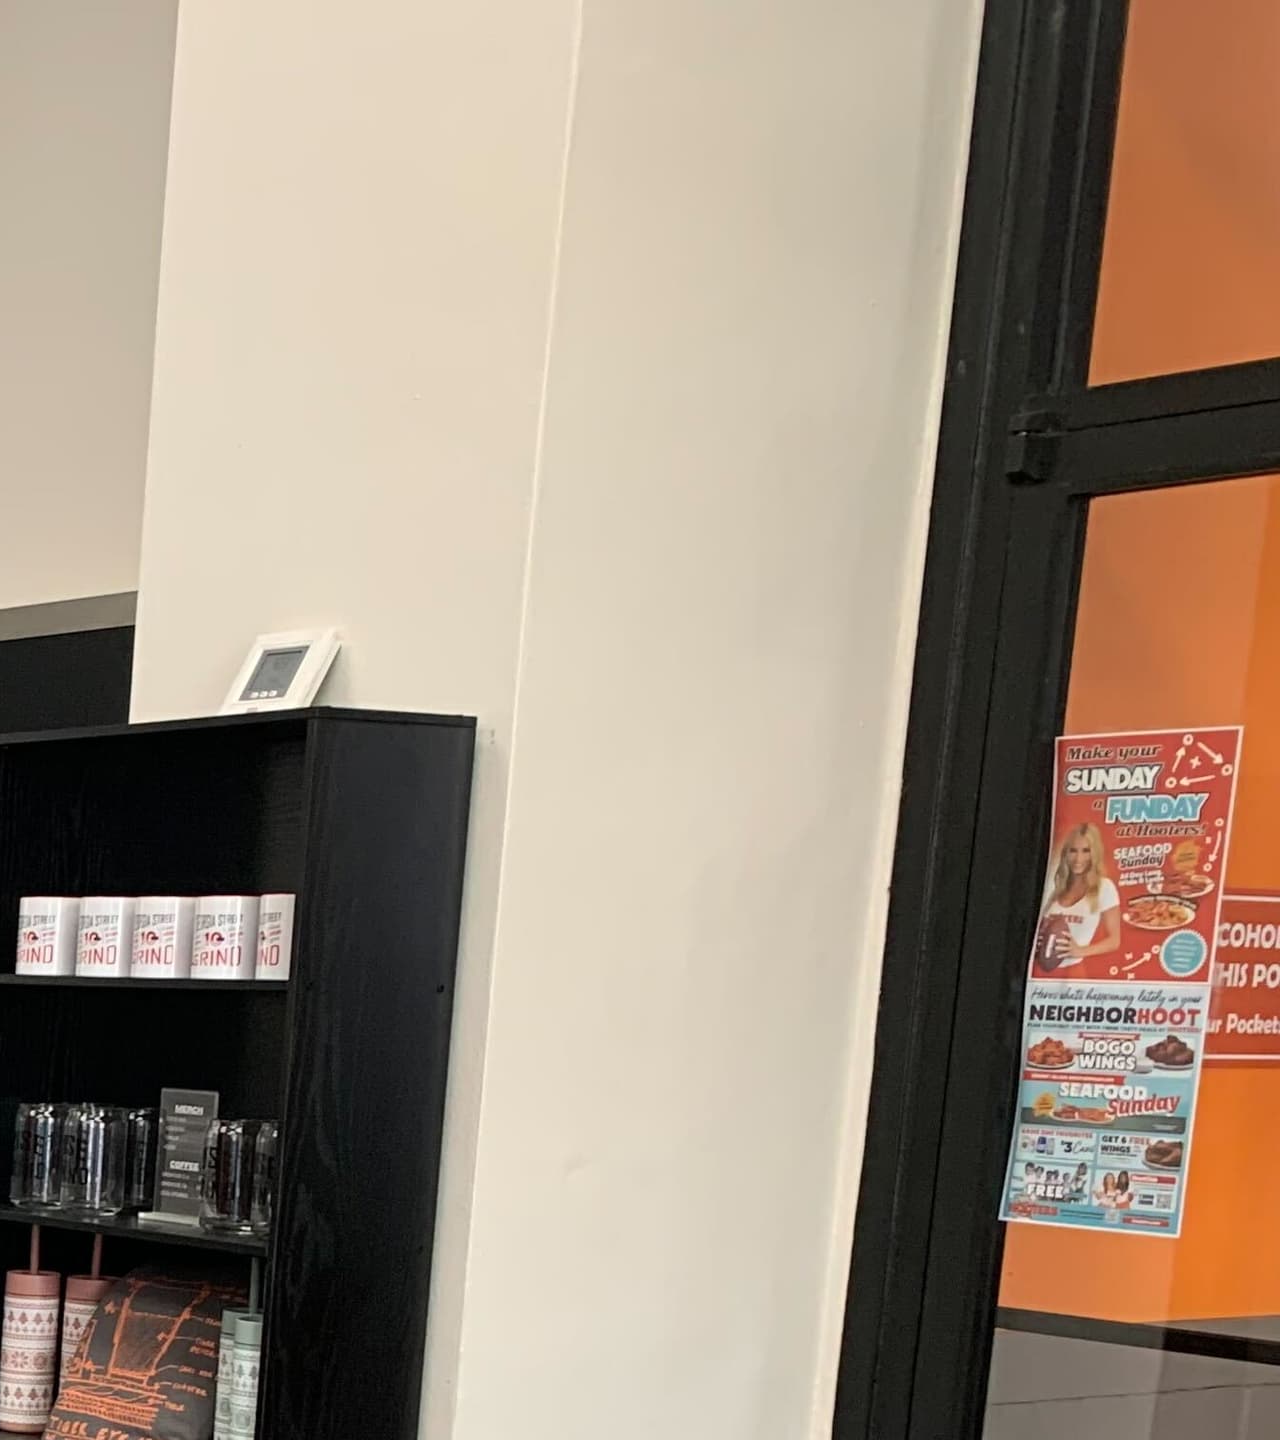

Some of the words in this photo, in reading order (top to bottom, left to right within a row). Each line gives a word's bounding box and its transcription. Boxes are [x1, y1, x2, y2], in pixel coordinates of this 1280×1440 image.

[1066, 745, 1113, 762] Make
[1117, 744, 1163, 761] your
[1066, 765, 1161, 793] SUNDAY
[1105, 793, 1209, 824] FUNDAY
[1116, 825, 1133, 838] at
[1113, 842, 1173, 860] SEAFOOD
[1119, 854, 1164, 869] Sunday
[17, 944, 54, 964] RIND
[79, 944, 117, 965] RIND
[1029, 1004, 1201, 1026] NEIGHBORHOOT
[1083, 1039, 1135, 1055] BOGO
[1078, 1053, 1137, 1071] WINGS
[1059, 1082, 1148, 1100] SEAFOOD
[174, 1104, 204, 1116] MERCH
[1107, 1094, 1181, 1117] Sunday
[1101, 1135, 1119, 1144] GET
[1100, 1145, 1131, 1154] WINGS
[169, 1160, 200, 1172] COFFEE
[1026, 1183, 1065, 1199] FREE
